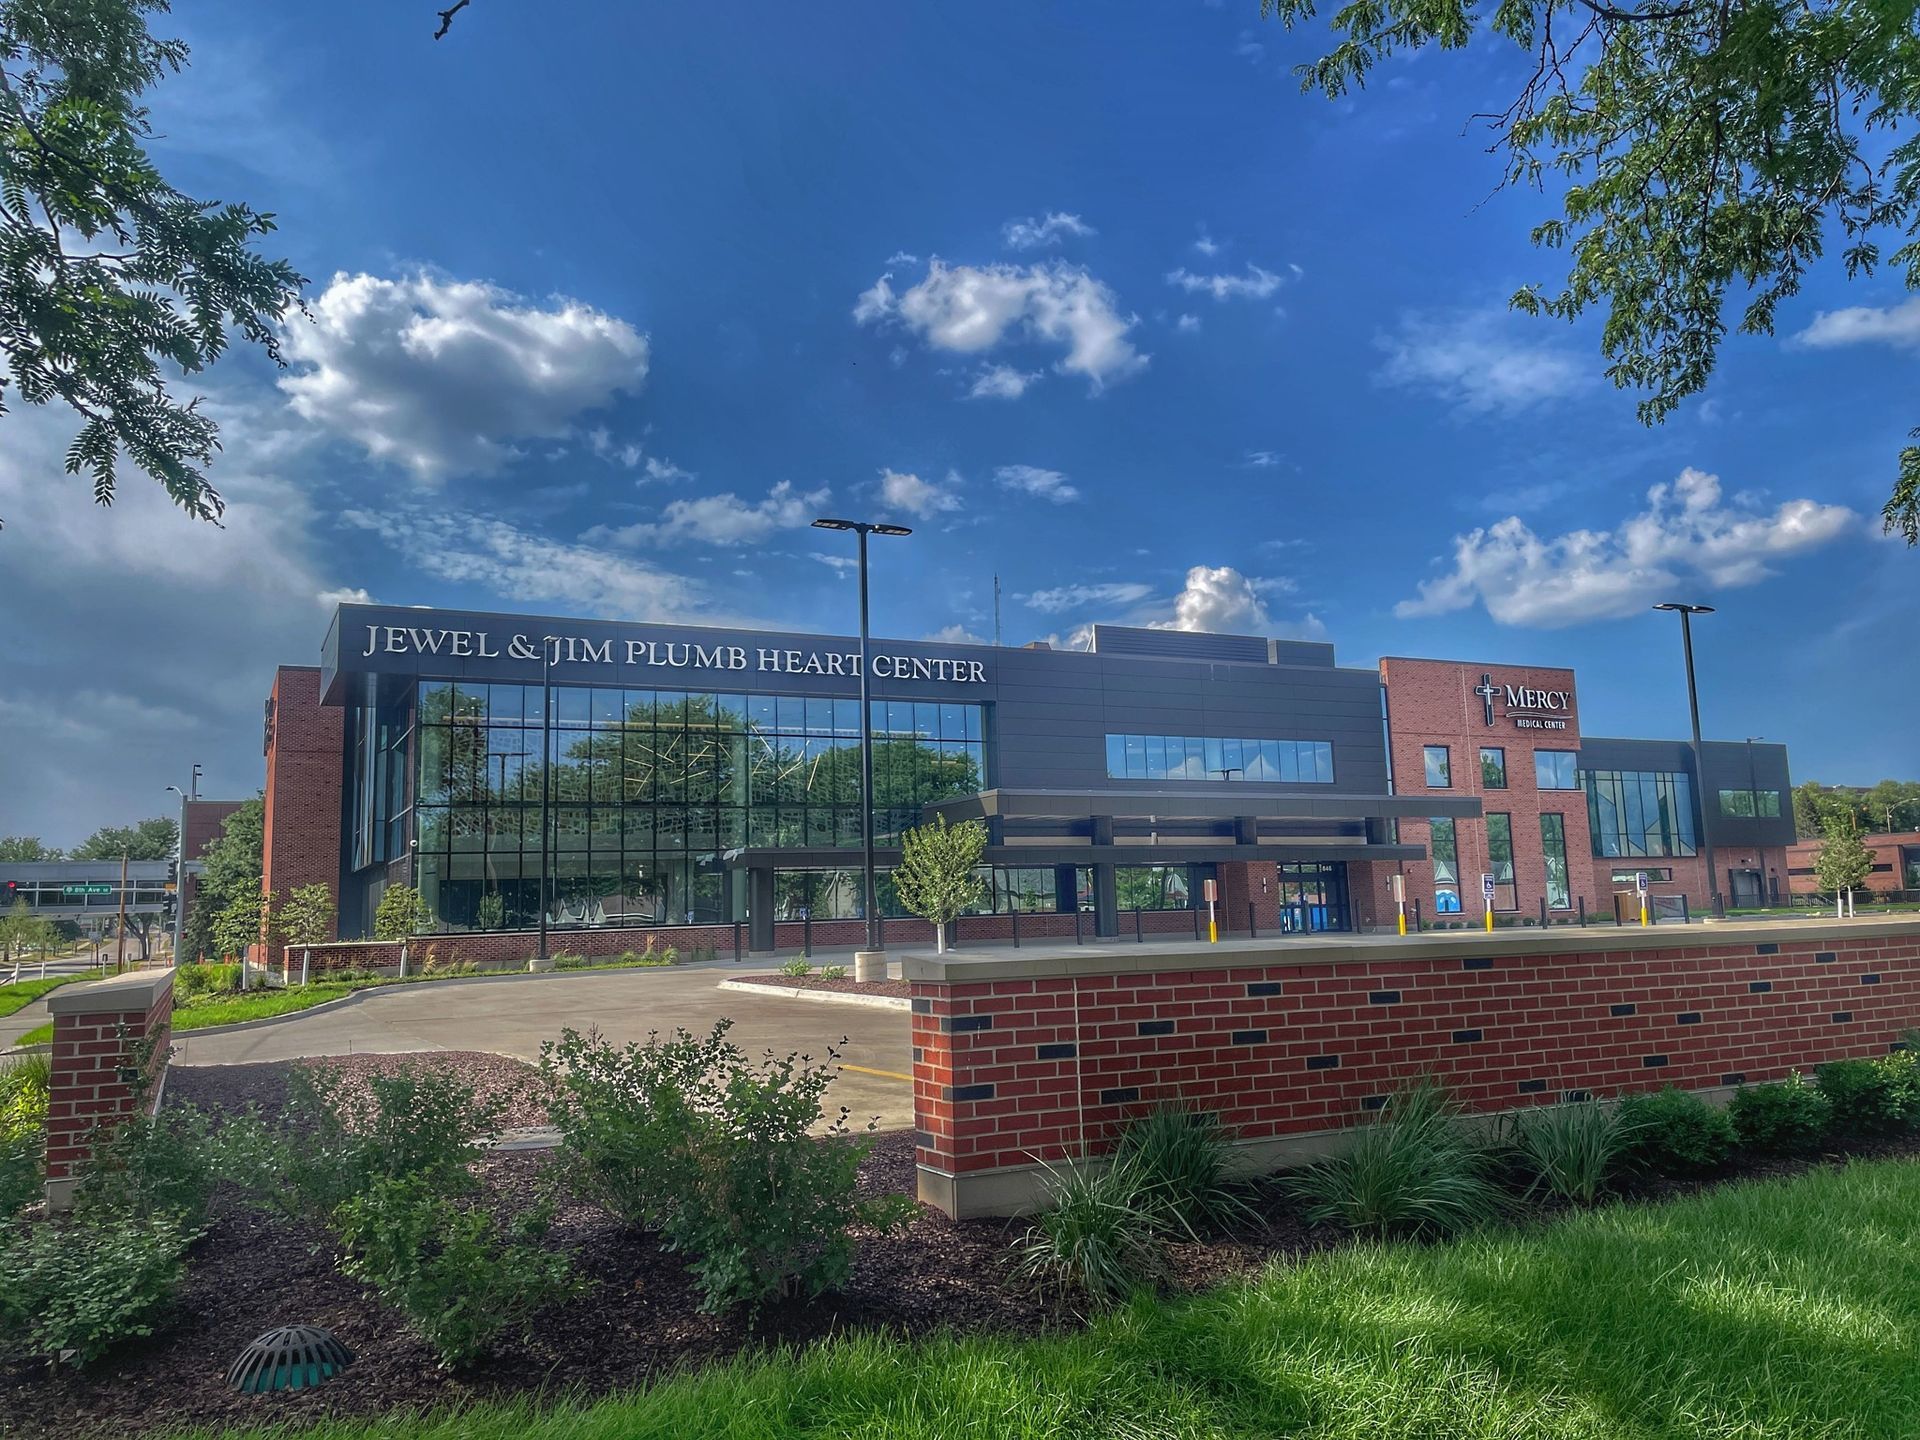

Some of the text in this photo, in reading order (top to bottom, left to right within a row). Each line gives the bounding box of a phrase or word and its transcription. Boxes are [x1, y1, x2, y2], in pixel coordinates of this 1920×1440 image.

[363, 625, 987, 682] JEWEL & JIM PLUMB HEART CENTER
[1505, 685, 1569, 709] MERCY
[1517, 720, 1566, 729] MEDICAL CENTER
